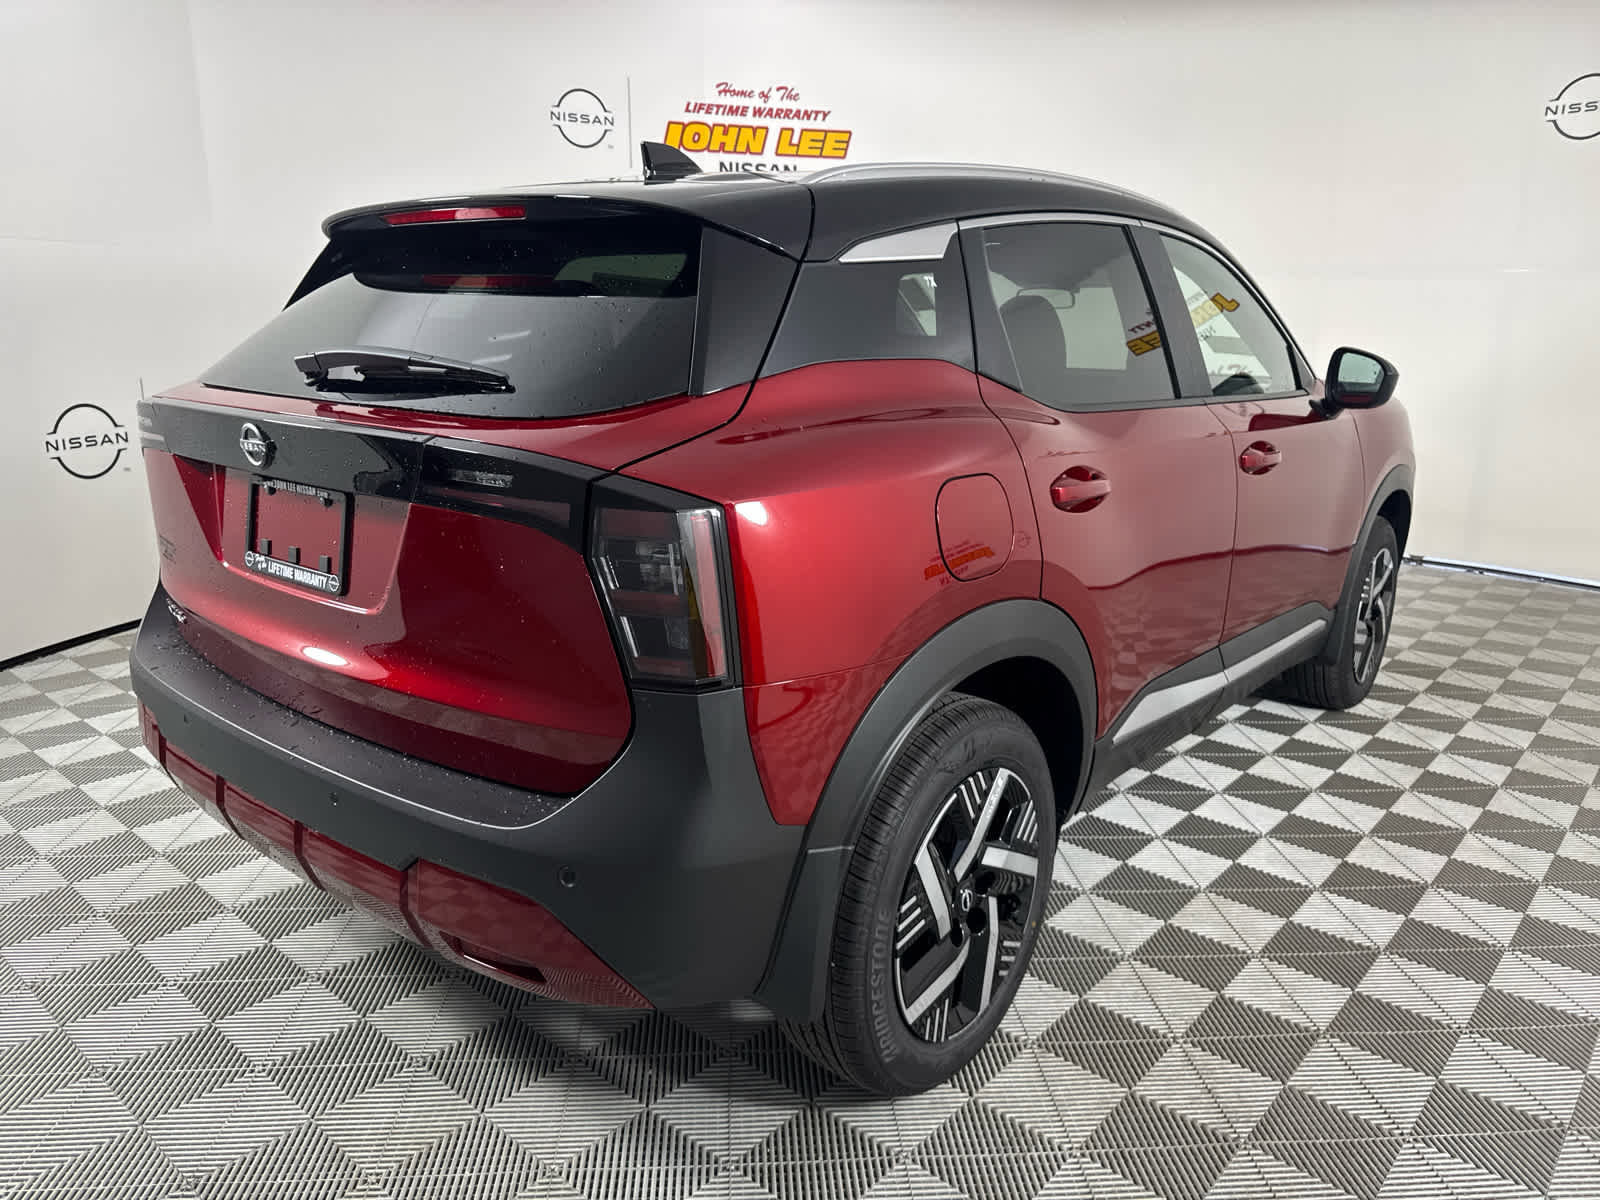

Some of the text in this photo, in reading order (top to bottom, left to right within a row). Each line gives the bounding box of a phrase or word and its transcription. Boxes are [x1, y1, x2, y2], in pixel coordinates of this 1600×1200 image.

[715, 82, 800, 104] Home of The
[550, 111, 614, 126] NISSAN
[684, 102, 832, 122] LIFETIME WARRANTY
[775, 127, 852, 160] LEE
[45, 432, 129, 453] NISSAN
[268, 560, 328, 589] LIFETIME WARRANTY
